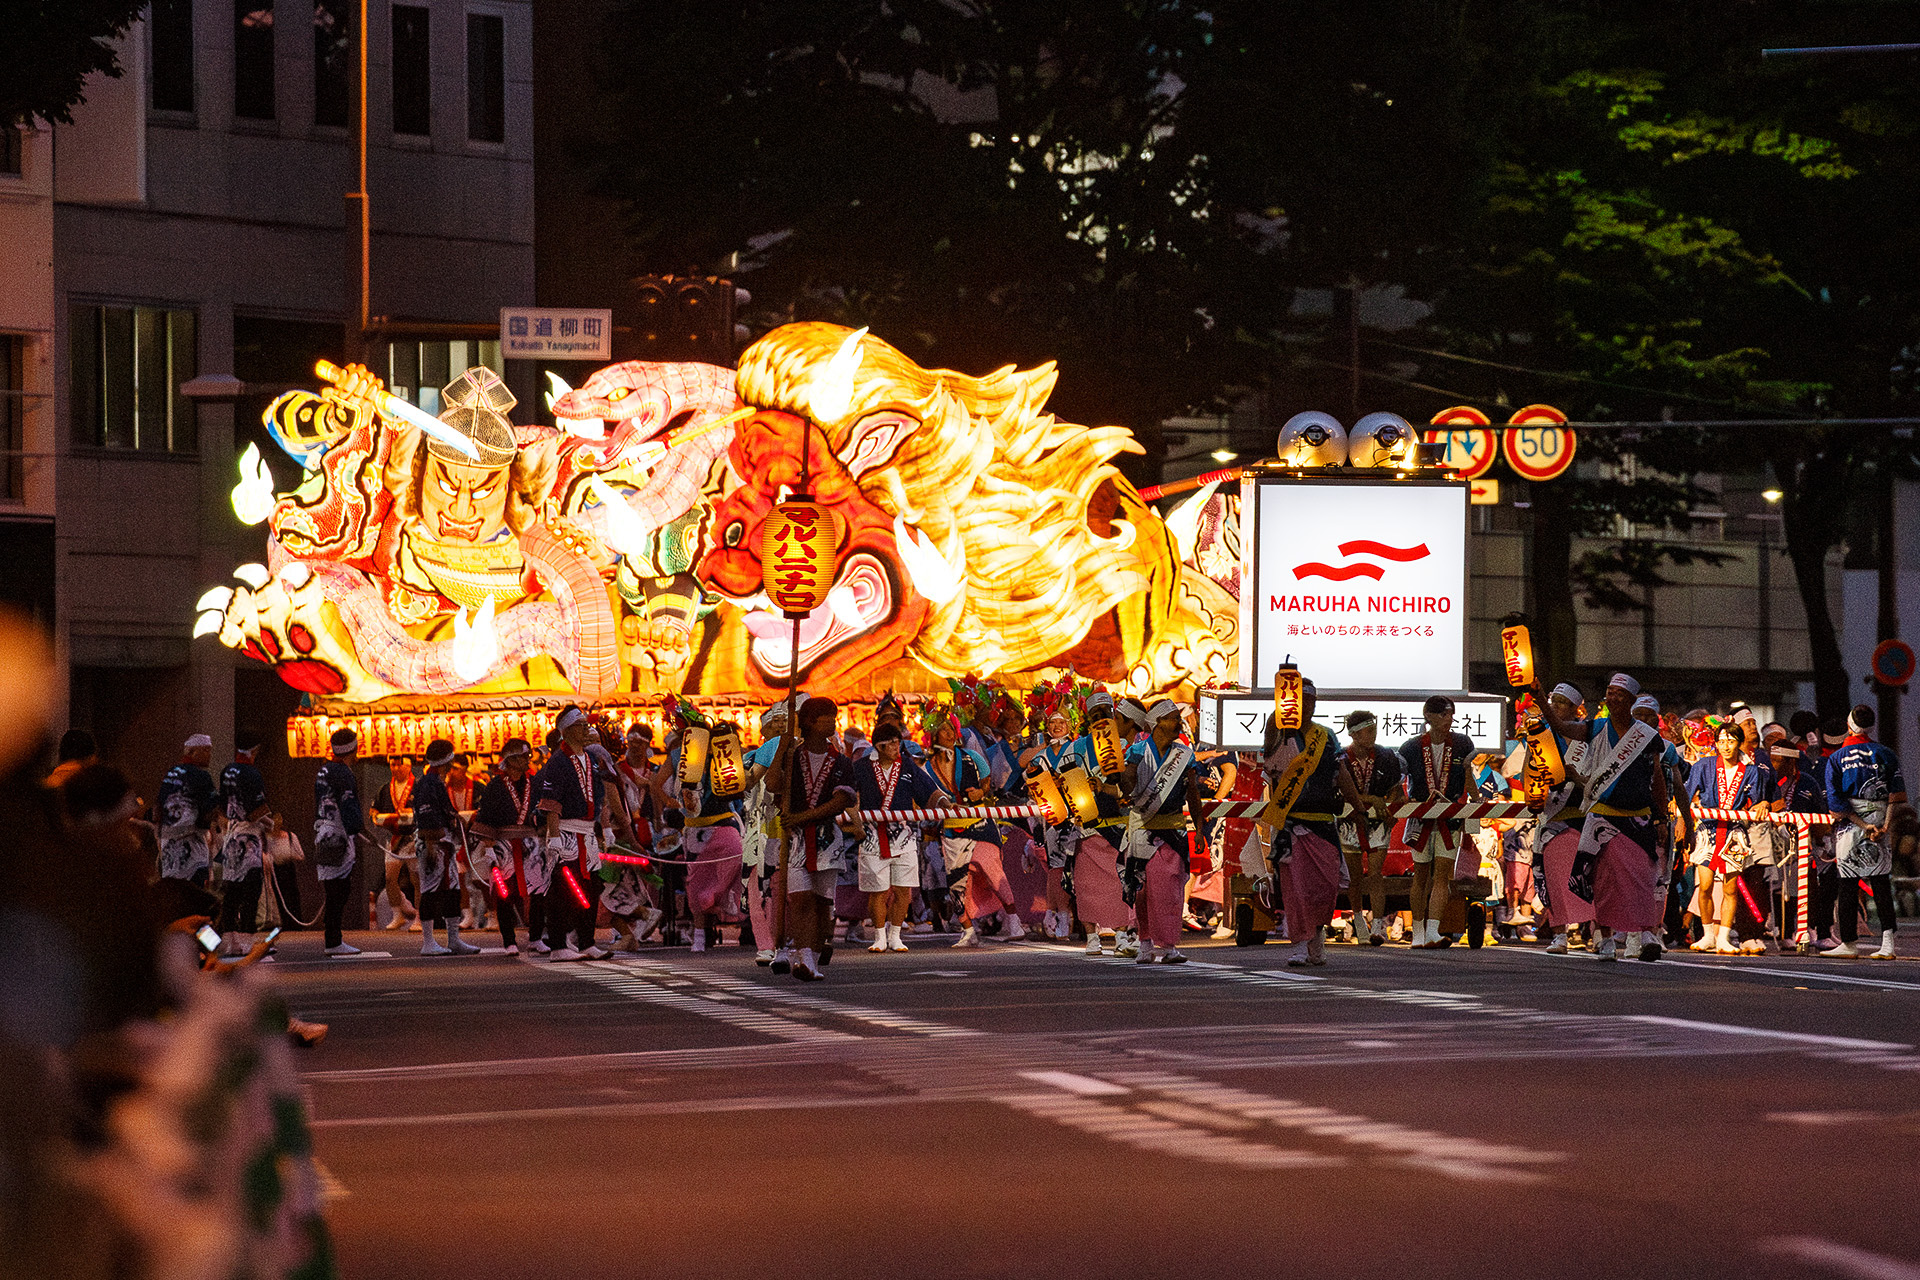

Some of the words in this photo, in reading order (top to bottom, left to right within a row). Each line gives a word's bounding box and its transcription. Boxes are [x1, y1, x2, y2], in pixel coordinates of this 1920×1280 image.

[509, 316, 602, 338] 国道柳町
[547, 340, 601, 353] Yanagimachi
[1522, 428, 1558, 457] 50
[774, 506, 820, 608] マルハニチロ
[1270, 595, 1360, 613] MARUHA
[1368, 596, 1451, 613] NICHIRO
[1287, 623, 1435, 637] 海といのちの未来をつくる
[1501, 630, 1524, 685] マルハニチロ
[1279, 672, 1299, 728] マルハニチロ
[1618, 729, 1646, 761] マルハニチロ
[713, 738, 740, 792] マルハニチロ
